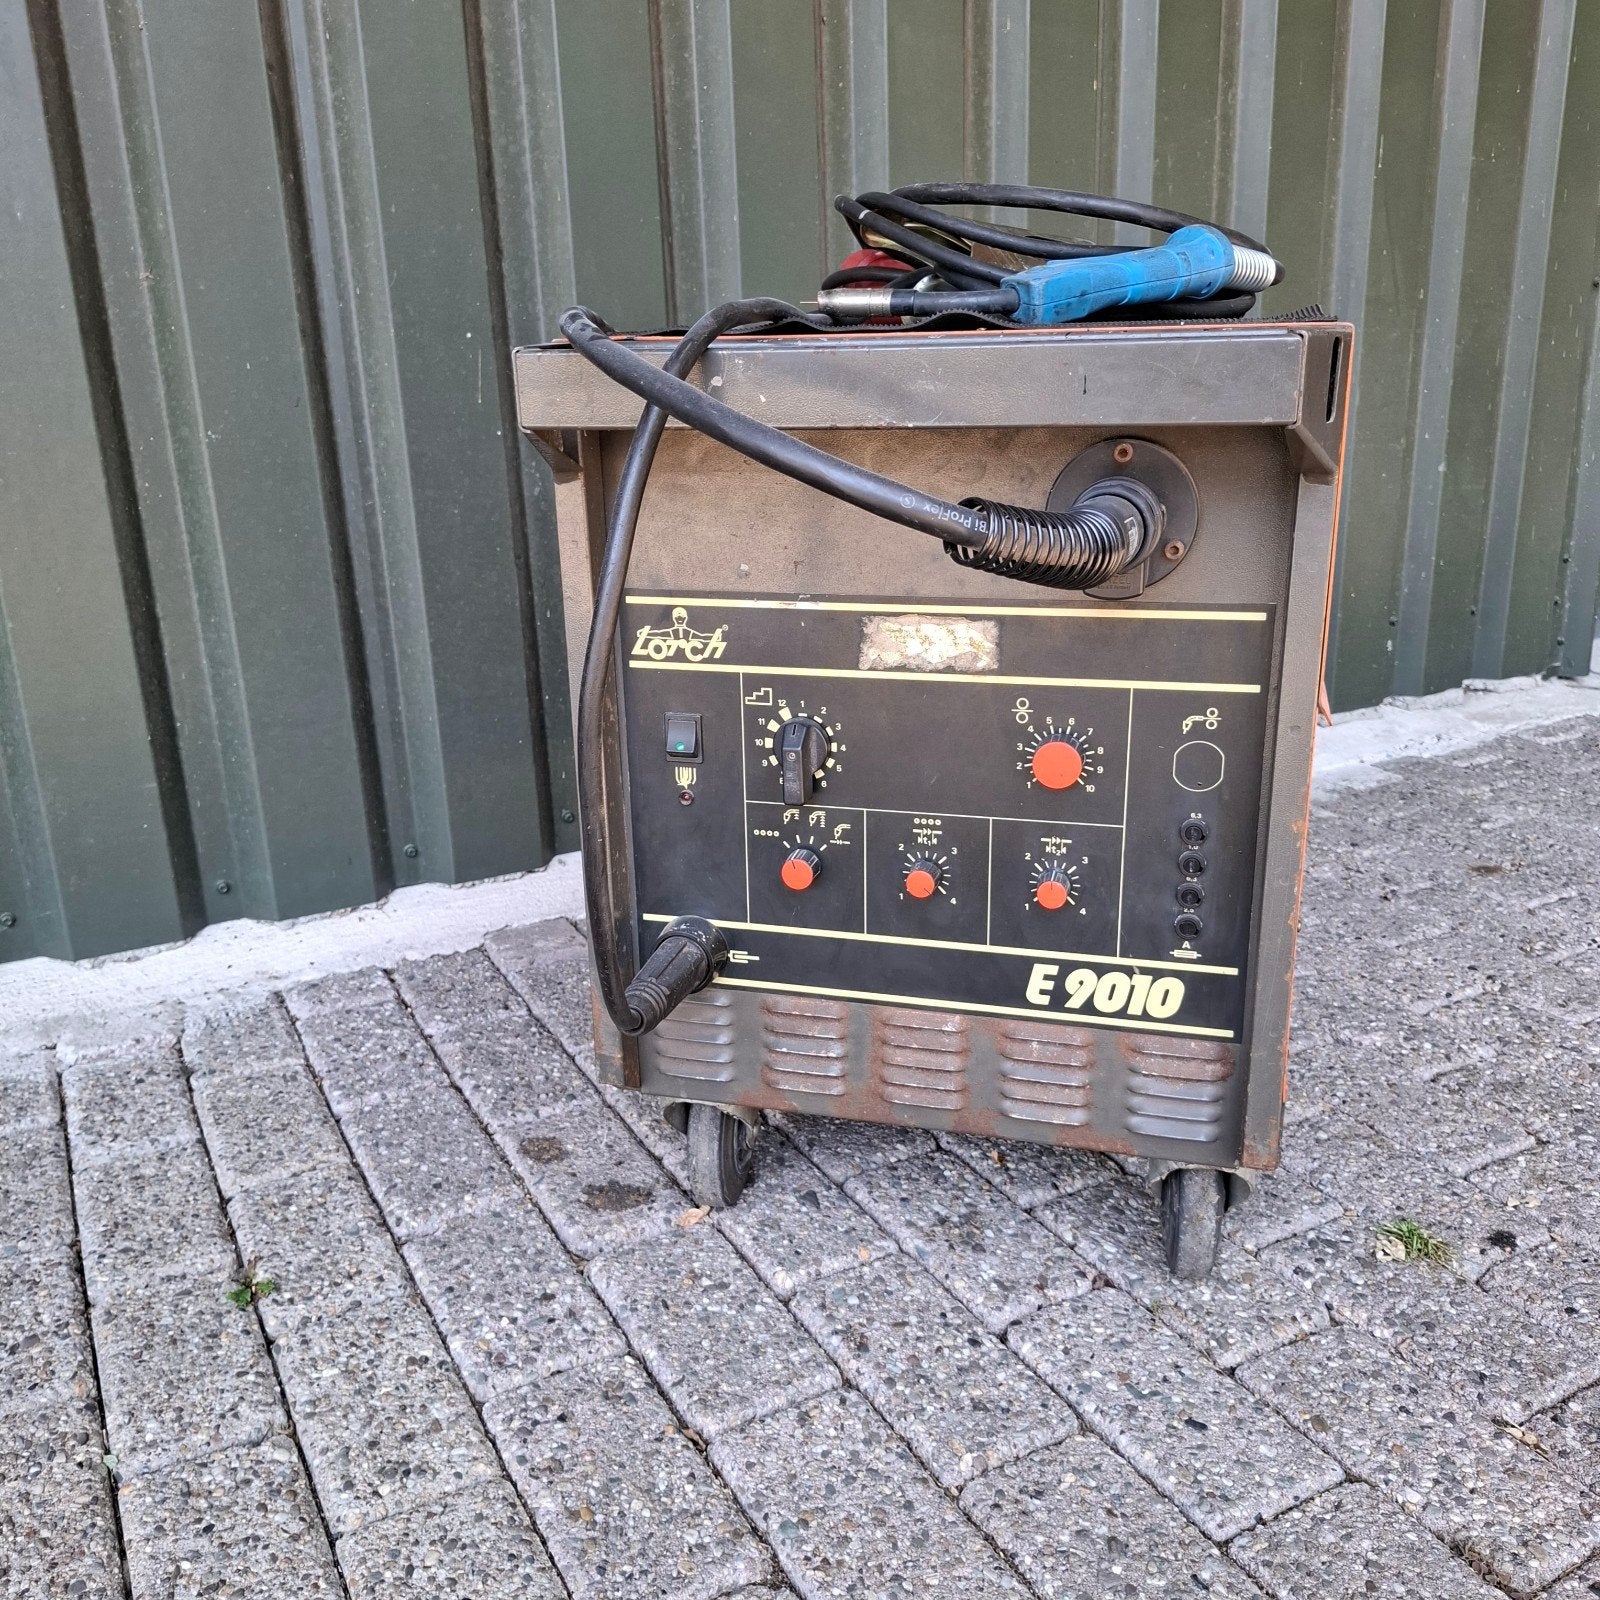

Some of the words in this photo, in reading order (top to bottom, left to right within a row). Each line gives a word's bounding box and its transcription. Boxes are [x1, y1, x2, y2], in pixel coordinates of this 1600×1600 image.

[923, 503, 972, 528] ProFlex
[1087, 728, 1094, 736] 7
[1182, 941, 1191, 949] A
[1025, 963, 1059, 1006] E
[1064, 968, 1185, 1019] 9010
